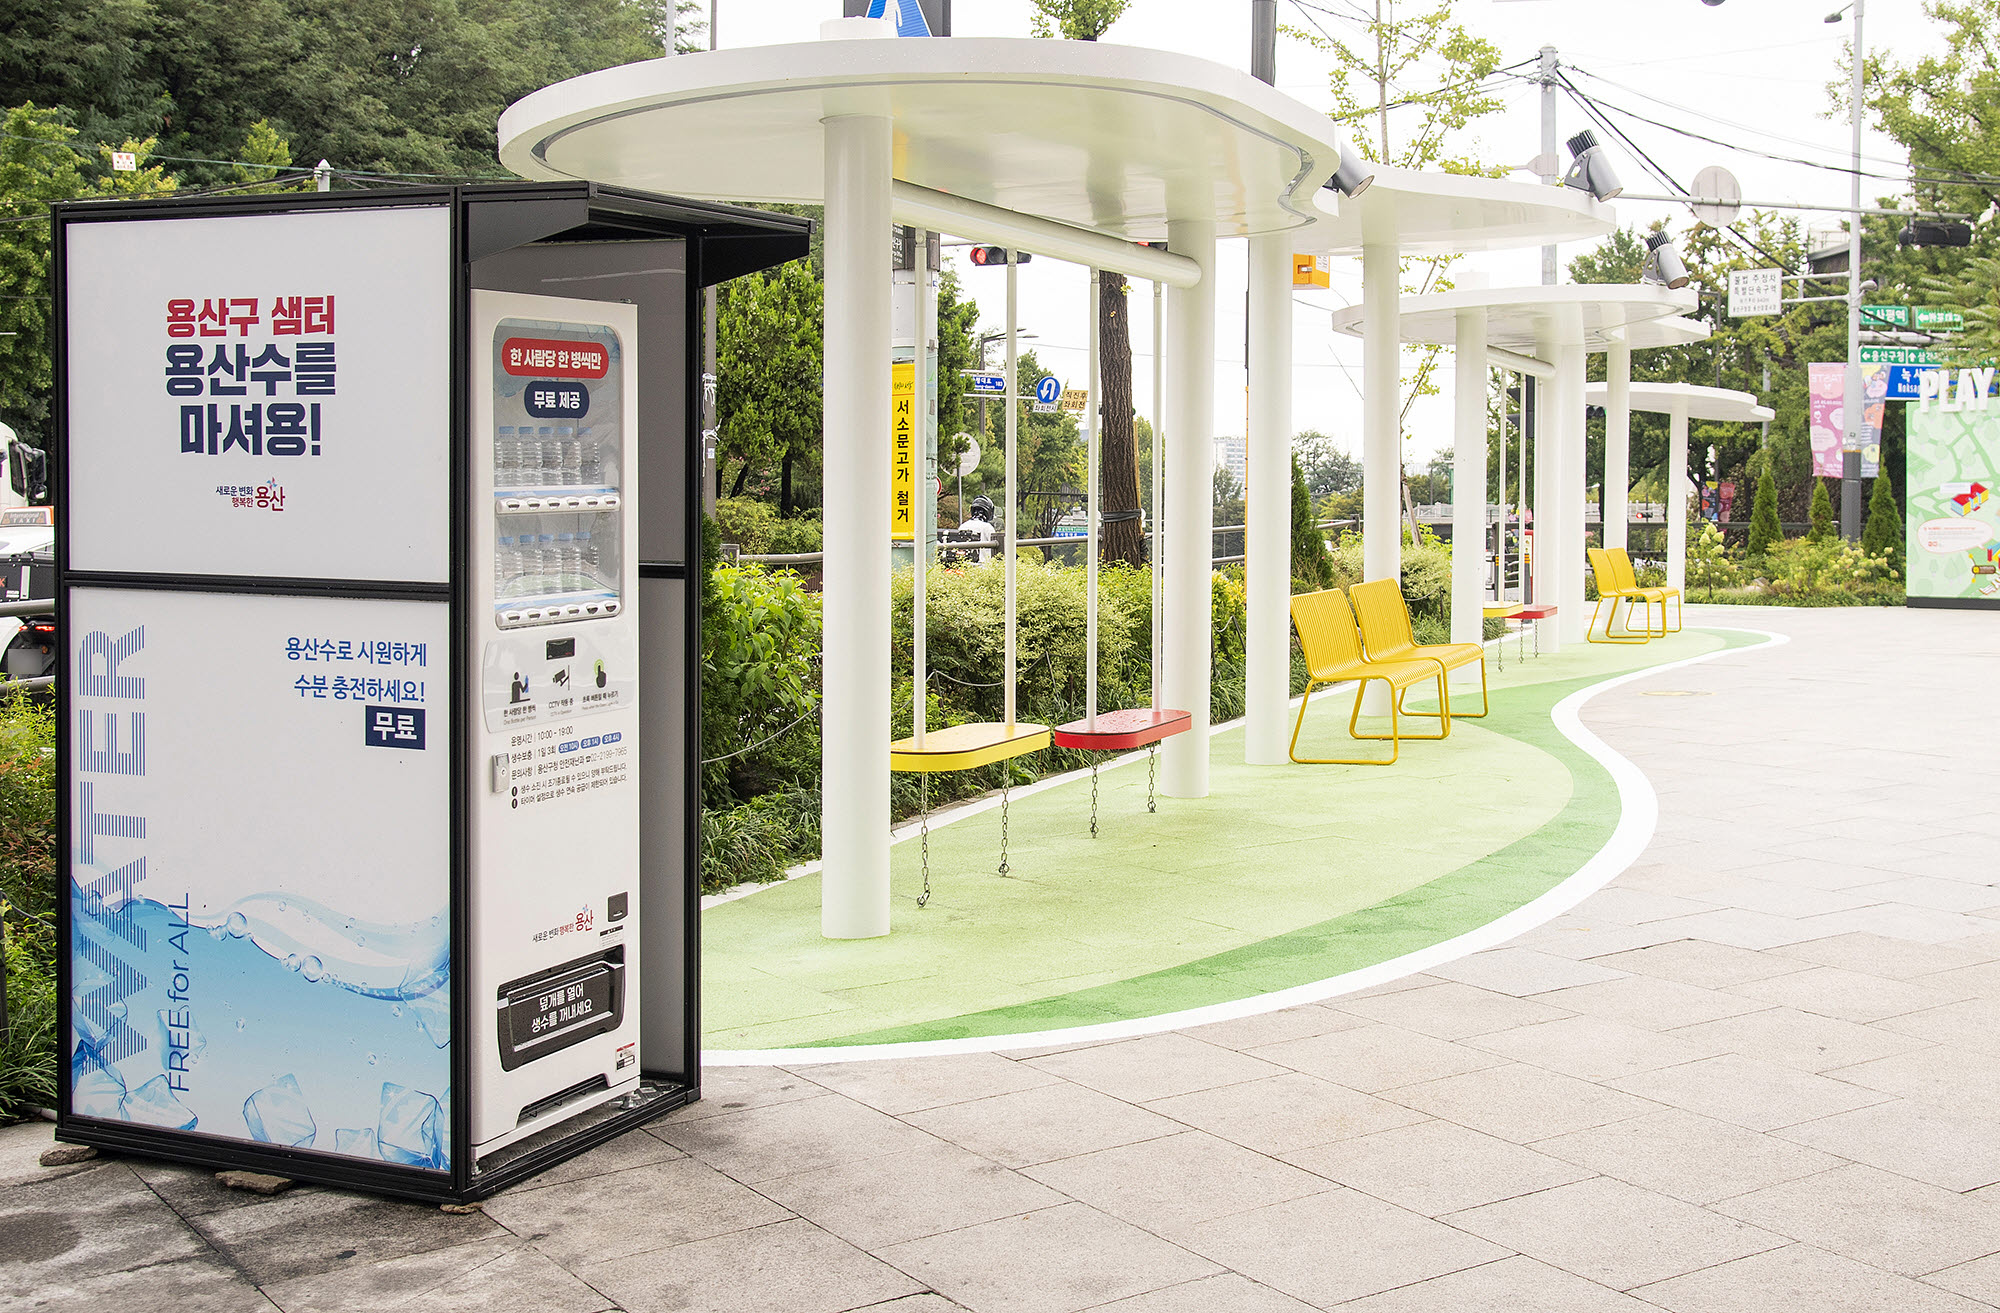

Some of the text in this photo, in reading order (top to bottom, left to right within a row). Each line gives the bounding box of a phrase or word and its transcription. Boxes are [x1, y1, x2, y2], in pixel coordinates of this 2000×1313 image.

[167, 295, 335, 337] 용산구 샘터
[1864, 309, 1906, 321] 녹사평역
[165, 342, 337, 396] 용산수를
[510, 347, 602, 370] 한 사람당 한 병씩만
[1871, 350, 1906, 362] 용산구청
[1901, 368, 1920, 382] 녹사
[534, 391, 581, 410] 무료 제공
[1920, 367, 1996, 414] PLAY
[180, 403, 321, 456] 마셔용!
[897, 400, 910, 523] 서소문고가 철거
[216, 485, 254, 496] 새로운 변화
[232, 486, 286, 511] 행복한 용산
[285, 637, 427, 667] 용산수로 시원하게
[294, 674, 425, 703] 수분 충전하세요!
[548, 700, 560, 709] CCTV
[372, 712, 418, 741] 무료
[511, 733, 533, 747] 운영시간
[538, 729, 552, 741] 10:00
[558, 725, 573, 737] 19:00
[511, 749, 533, 763] 생수보충
[537, 747, 546, 758] 1일
[547, 744, 557, 755] 3회
[511, 766, 533, 780] 문의사항
[538, 760, 558, 775] 용산구청
[521, 784, 530, 794] 생수
[531, 781, 541, 791] 소진
[79, 625, 148, 1076] WATER
[532, 909, 594, 942] 새로운 변화 행복한 용산
[167, 892, 189, 1092] FREE for ALL
[539, 983, 584, 1012] 덮개를 열어
[531, 998, 593, 1033] 생수를 꺼내세요
